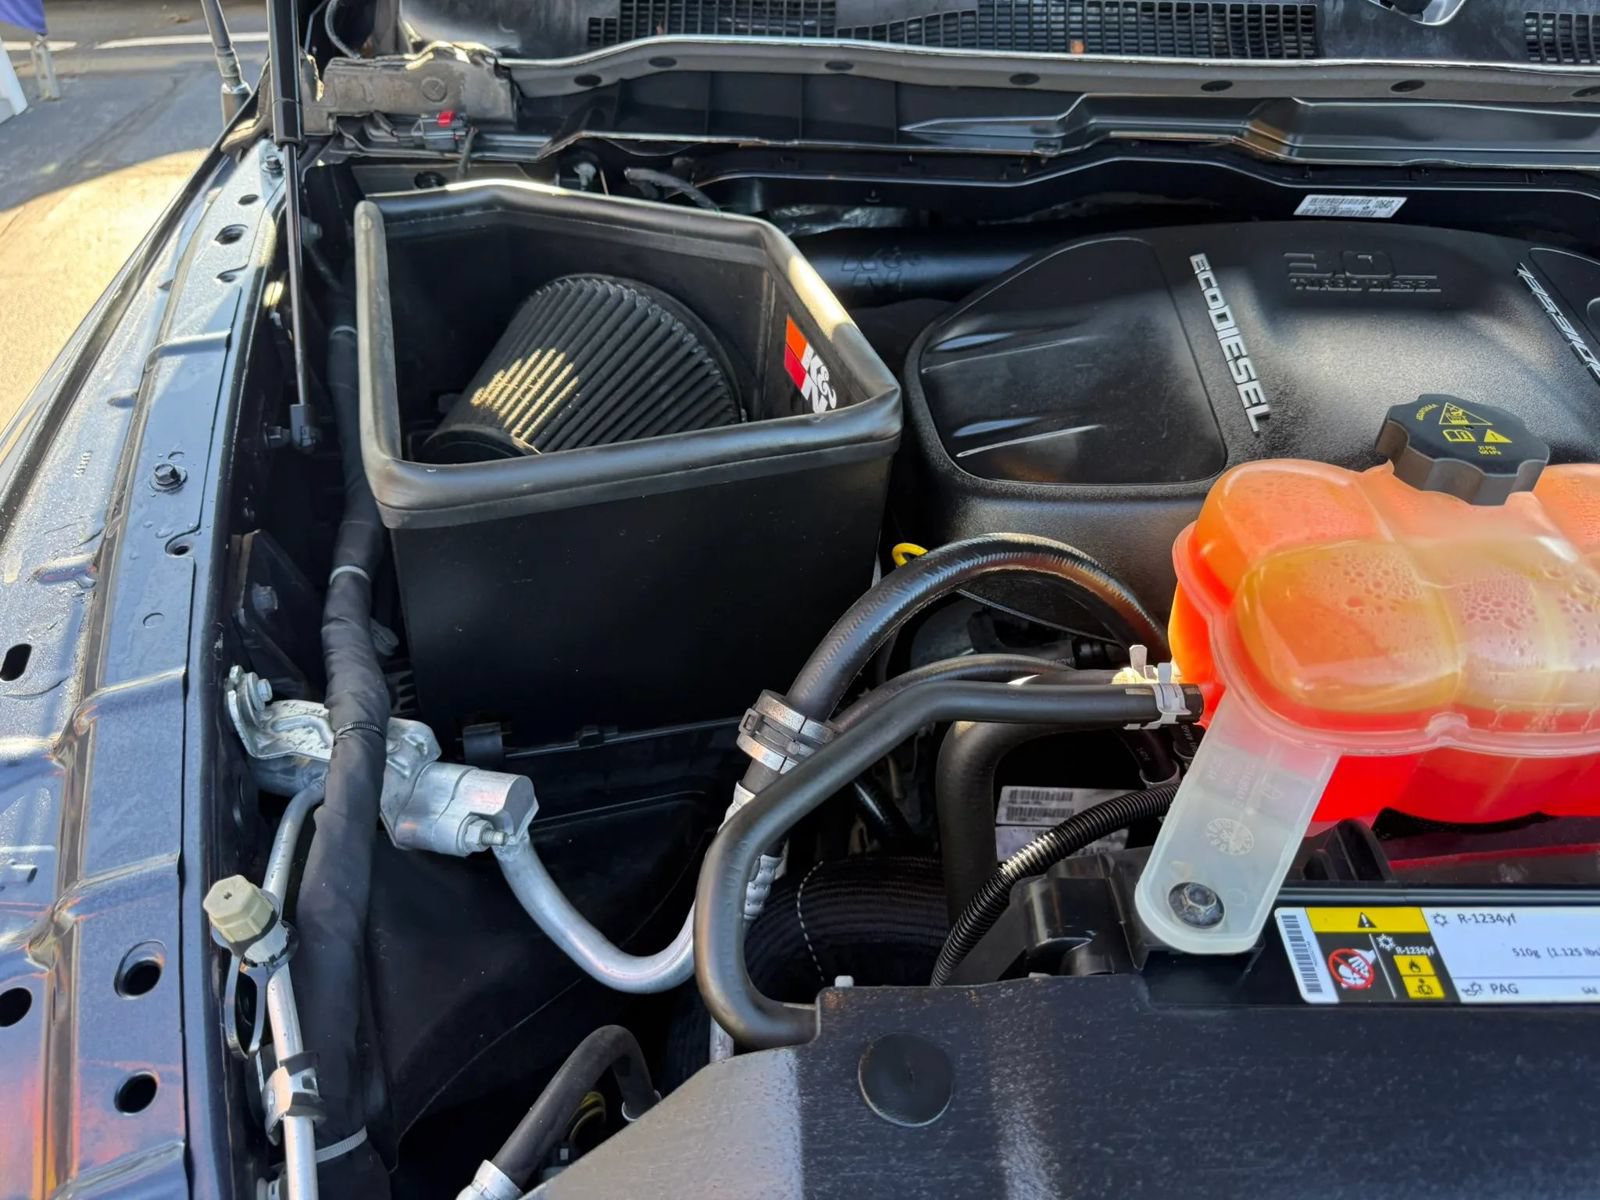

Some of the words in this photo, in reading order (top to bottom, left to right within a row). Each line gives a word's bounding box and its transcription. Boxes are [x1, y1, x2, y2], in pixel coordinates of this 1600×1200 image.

[1189, 253, 1270, 434] ECODIESEL
[1457, 912, 1517, 926] R-1234yf
[1395, 945, 1435, 956] R-1234yf
[1512, 947, 1541, 959] 510g
[1489, 982, 1519, 994] PAG
